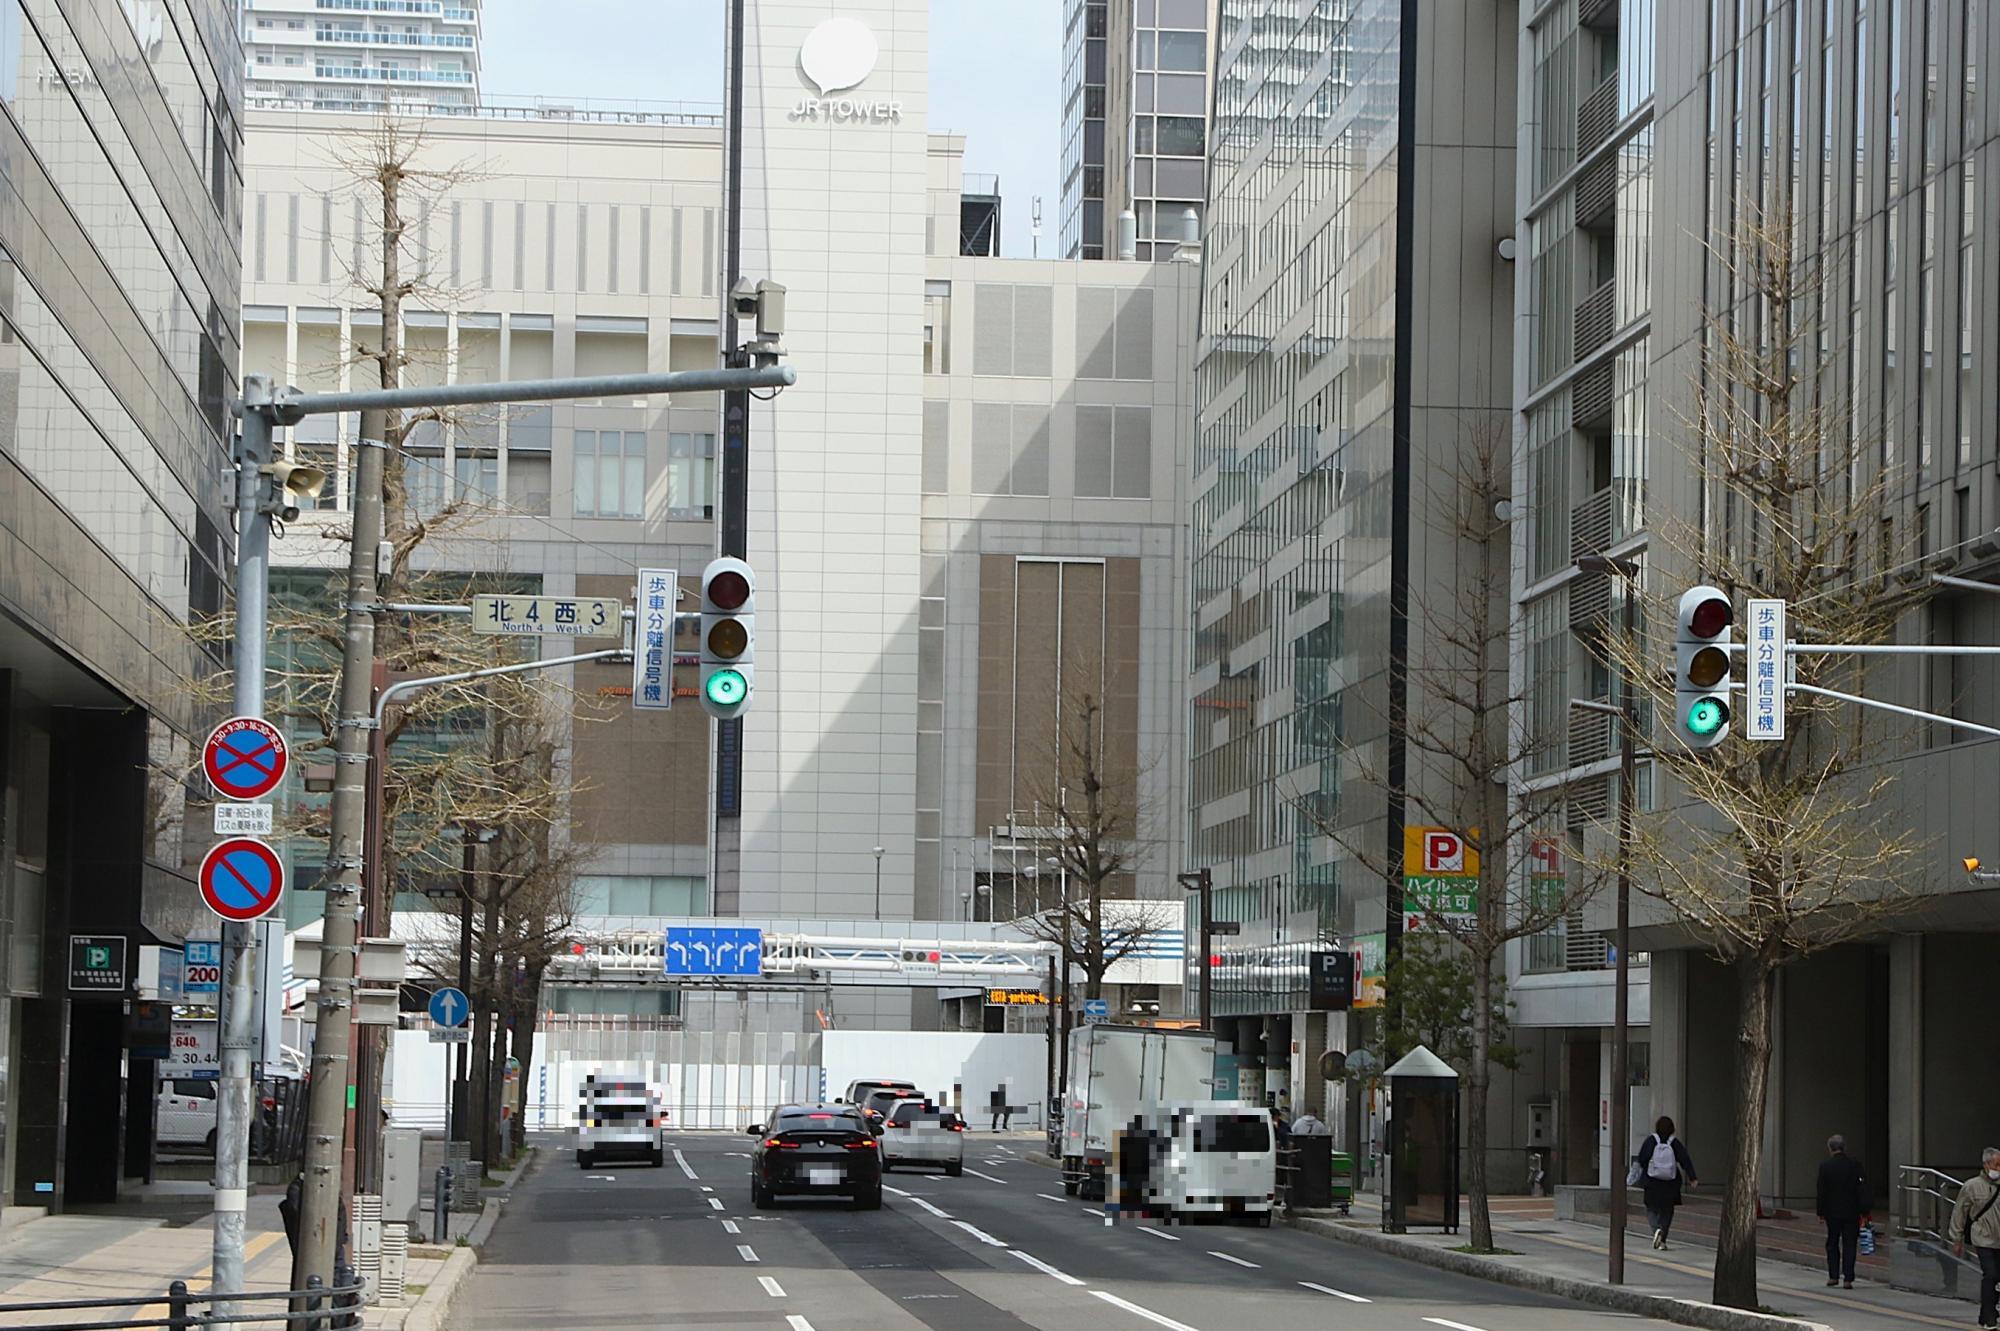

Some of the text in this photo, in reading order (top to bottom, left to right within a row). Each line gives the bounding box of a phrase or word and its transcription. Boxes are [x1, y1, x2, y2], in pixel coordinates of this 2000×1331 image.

[793, 98, 903, 118] JR TOWER
[502, 622, 595, 635] North 4 West 3
[643, 577, 667, 703] 歩車分離信号機
[1757, 608, 1776, 732] 歩車分離信号機
[1429, 835, 1458, 869] P
[1416, 894, 1472, 911] 駐車可
[91, 950, 106, 967] P
[1322, 955, 1337, 972] P
[188, 967, 219, 983] 200
